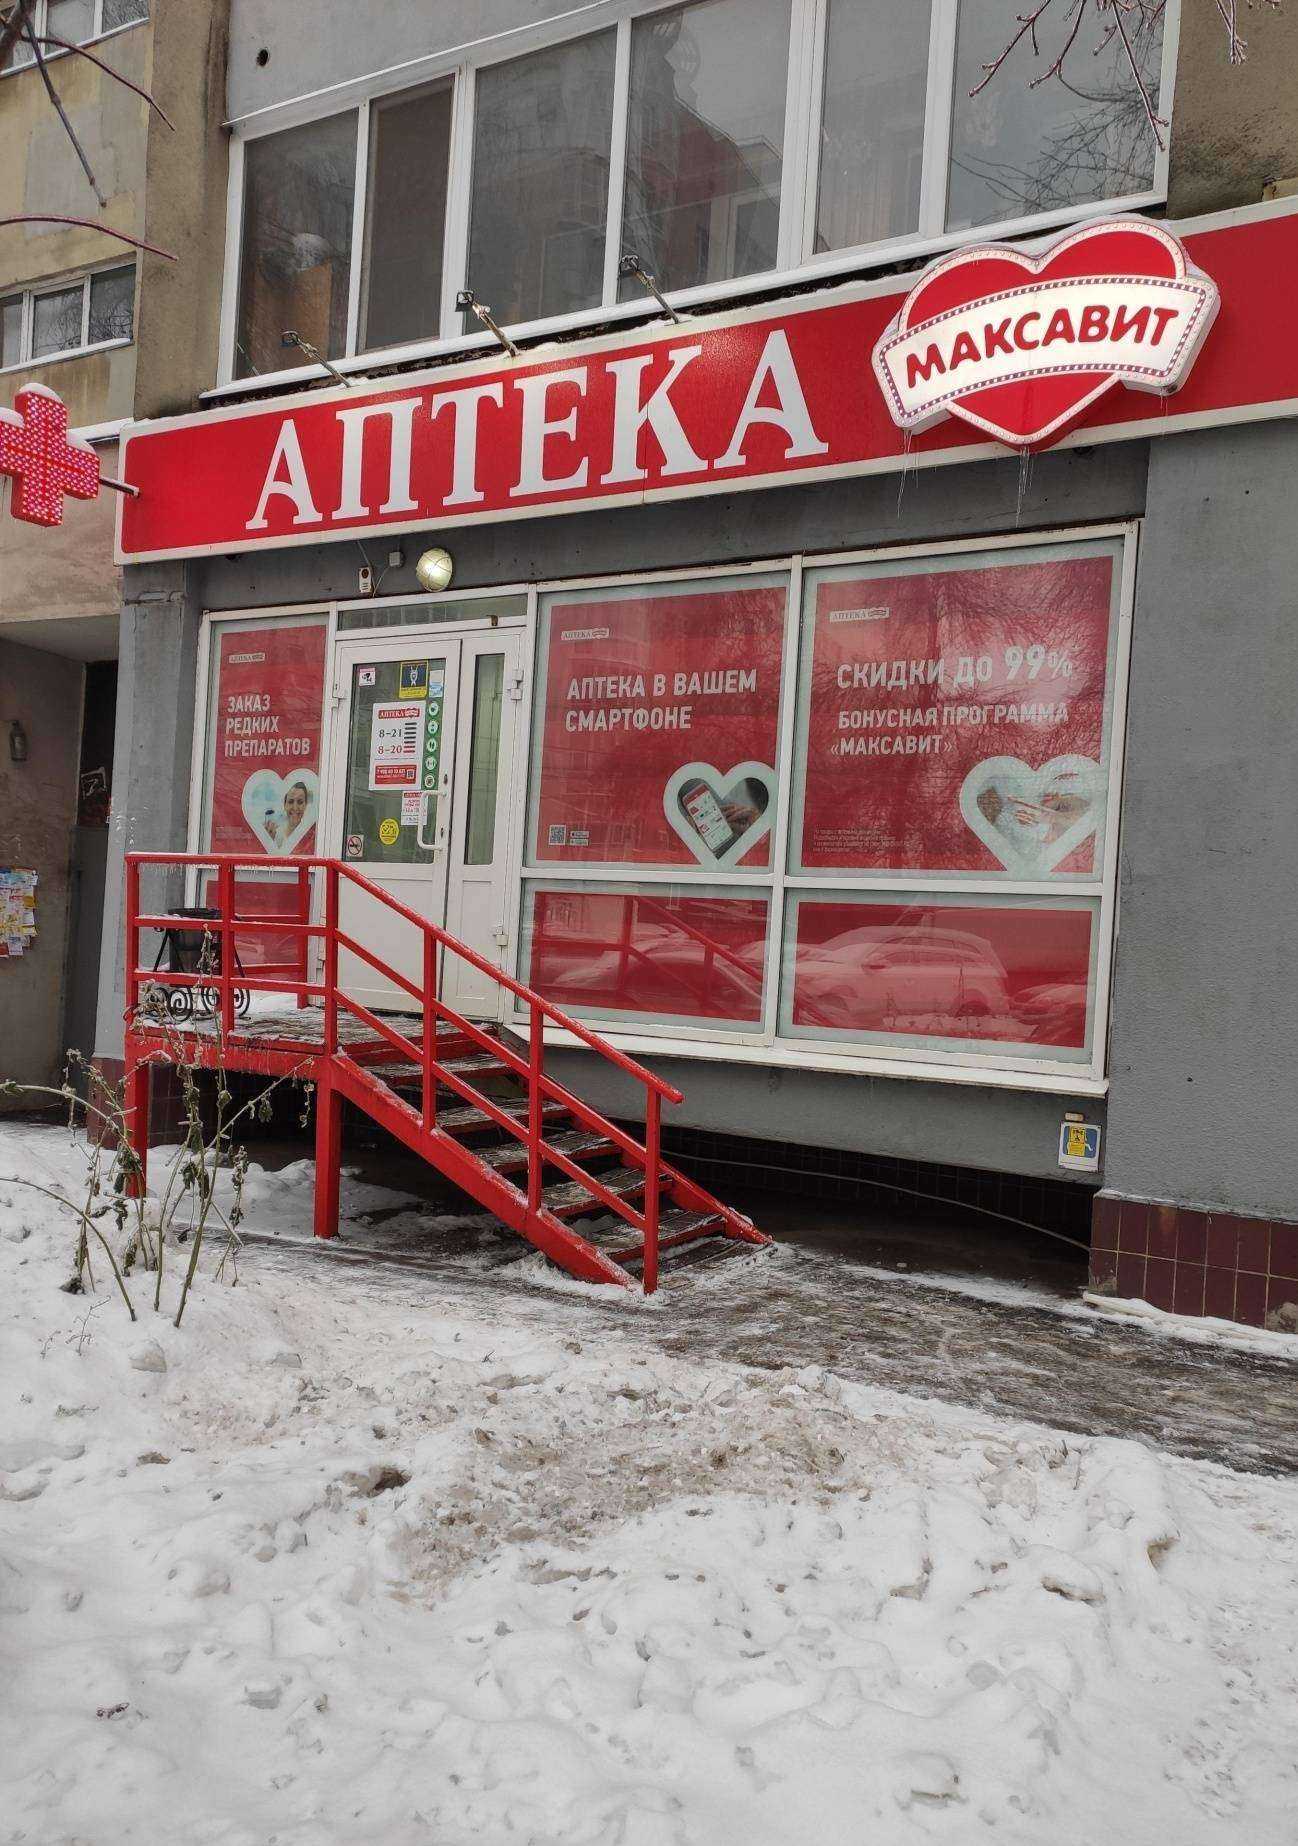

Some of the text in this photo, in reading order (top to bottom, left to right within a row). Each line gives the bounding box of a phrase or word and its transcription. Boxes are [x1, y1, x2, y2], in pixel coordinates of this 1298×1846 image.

[906, 304, 1179, 389] МАКСАВИТ
[245, 328, 830, 531] АПТЕКА
[837, 643, 1073, 691] СКИДКИ ДО 99%
[566, 668, 757, 700] АПТЕКА В ВАШЕМ
[227, 694, 271, 713] ЗАКАЗ
[838, 702, 1069, 729] БОНУСНАЯ ПРОГРАММА
[225, 715, 280, 737] РЕДКИХ
[564, 705, 693, 732] СМАРТФОНЕ
[224, 737, 311, 758] ПРЕПАРАТОВ
[831, 734, 952, 755] «МАКСАВИТ»
